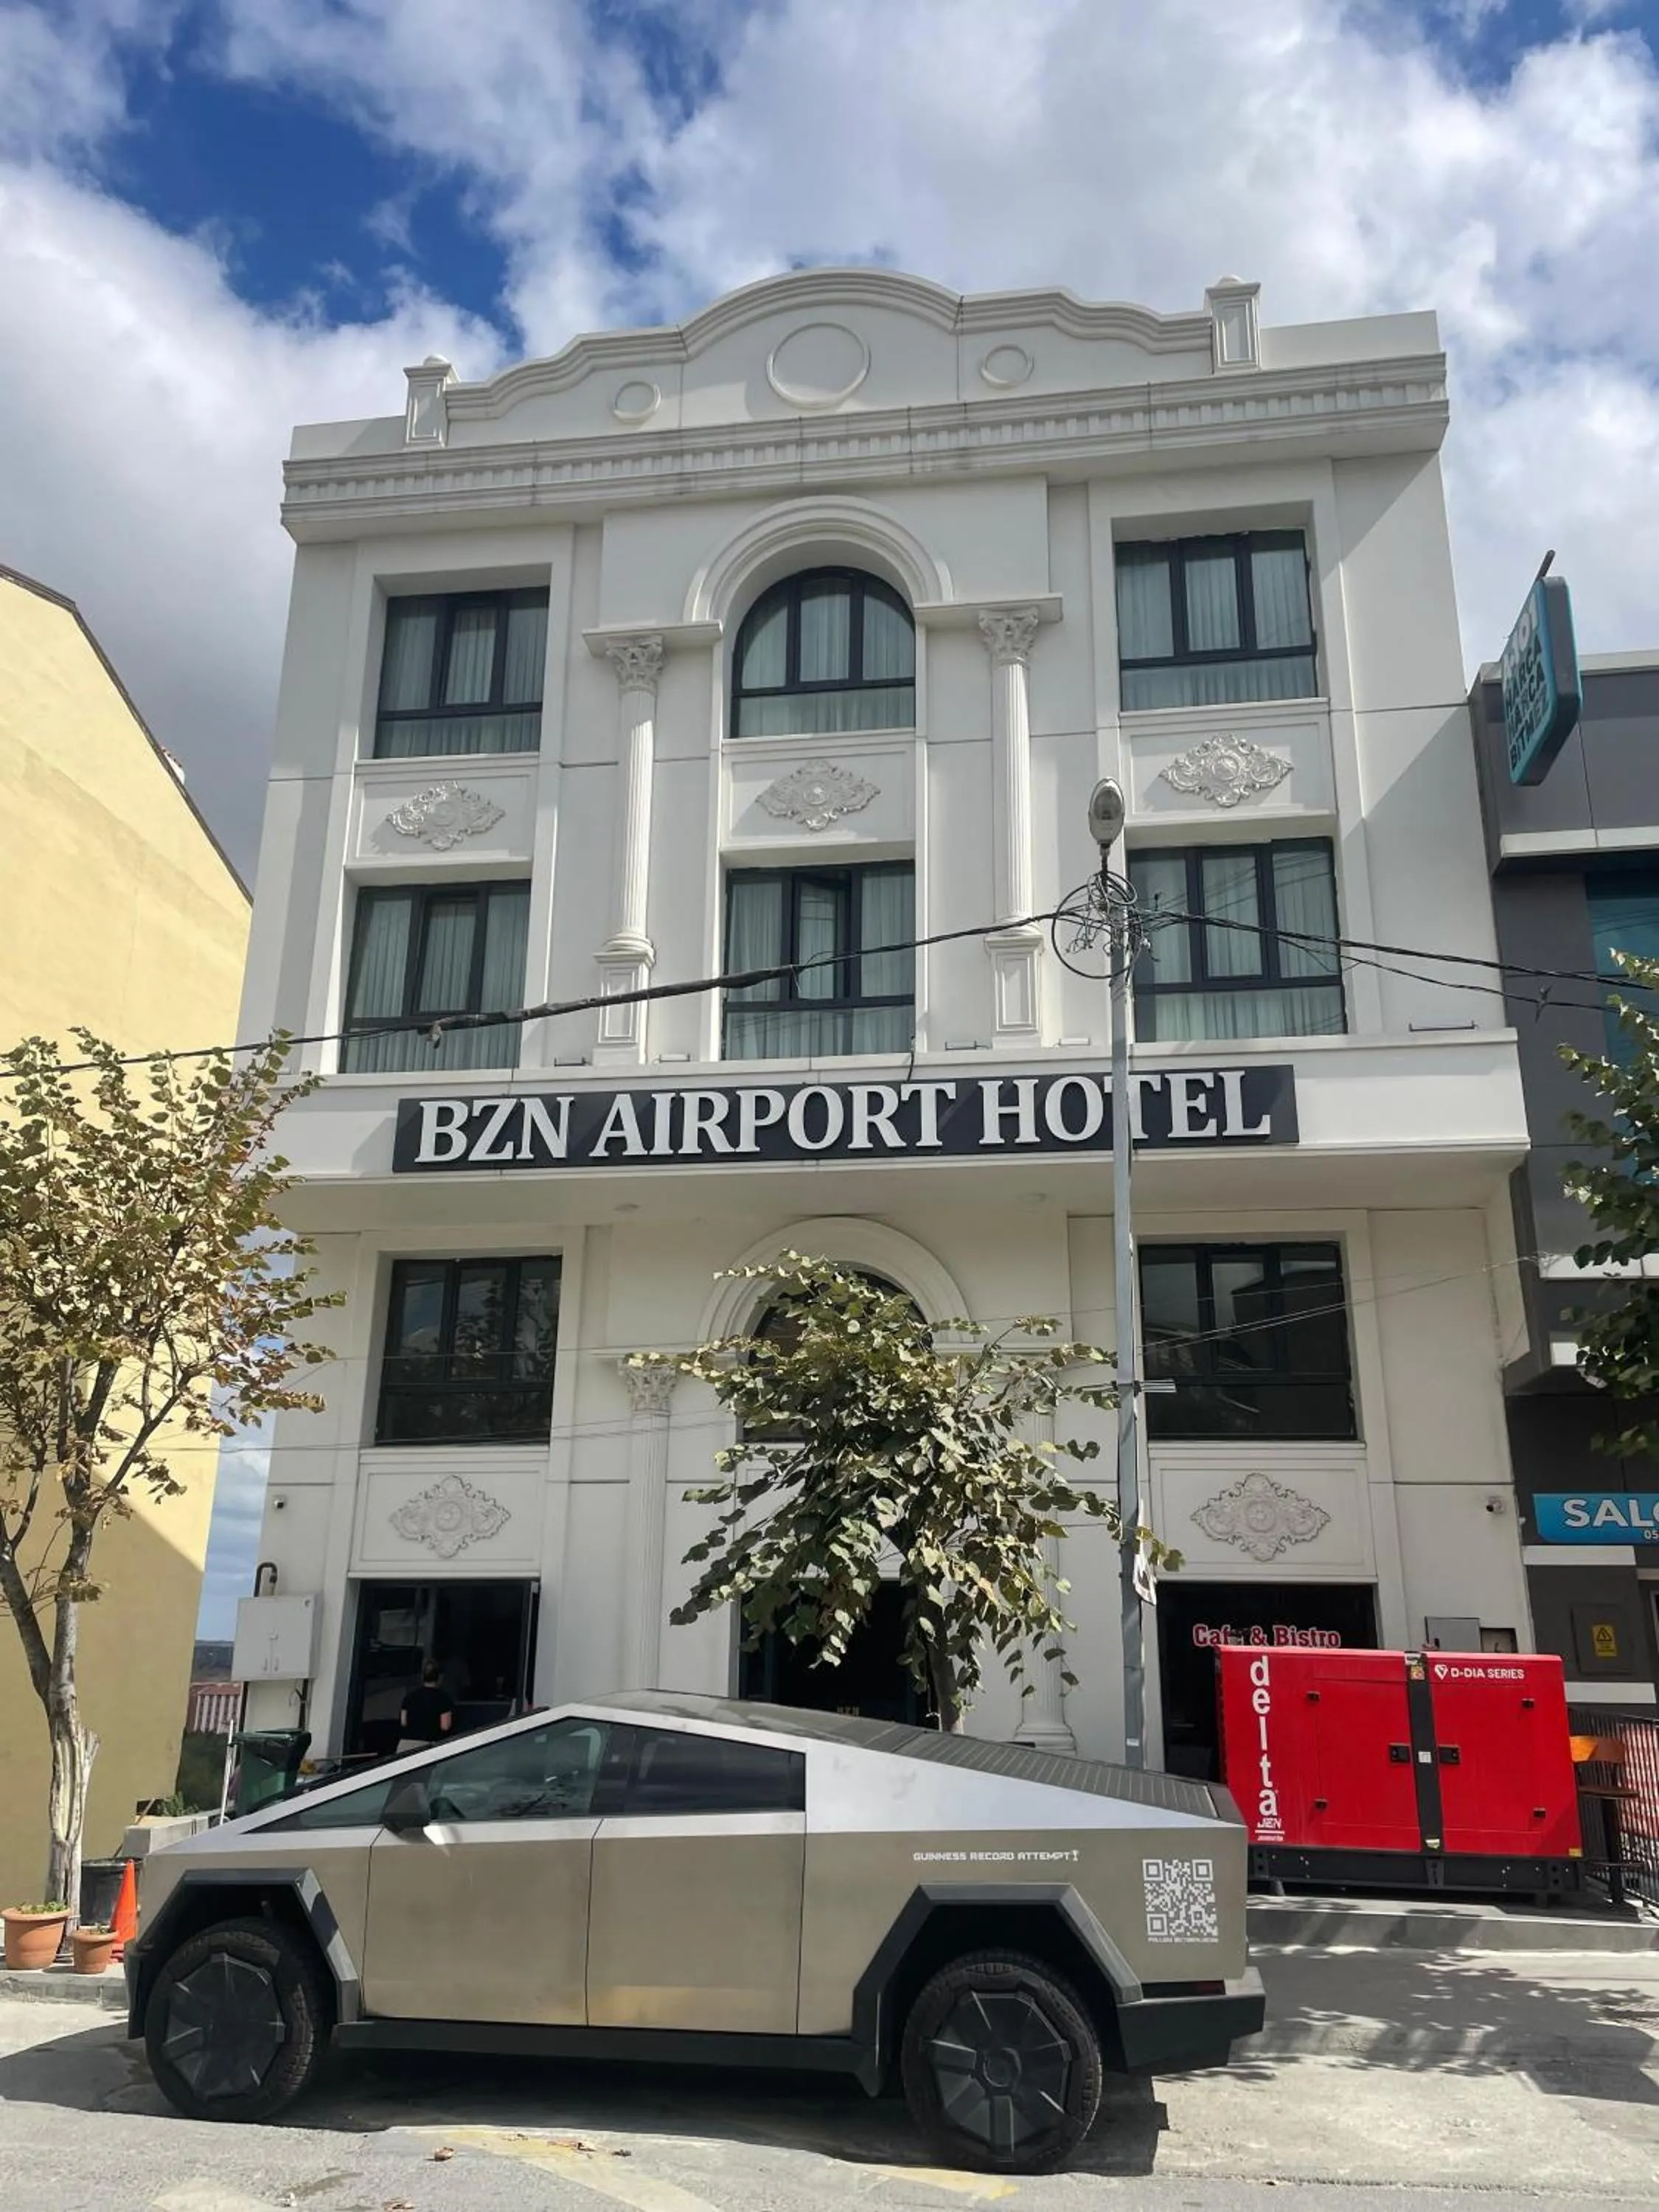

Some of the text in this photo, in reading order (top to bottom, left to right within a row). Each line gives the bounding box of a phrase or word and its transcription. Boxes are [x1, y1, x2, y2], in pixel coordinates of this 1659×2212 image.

[414, 1070, 1271, 1163] BZN AIRPORT HOTEL
[1563, 1499, 1659, 1528] SAL
[1251, 1625, 1269, 1646] &
[1273, 1625, 1341, 1648] Bistro
[1450, 1667, 1525, 1680] D-DIA SERIES
[913, 1850, 1070, 1862] GUINNESS RECORD ATTEMPT
